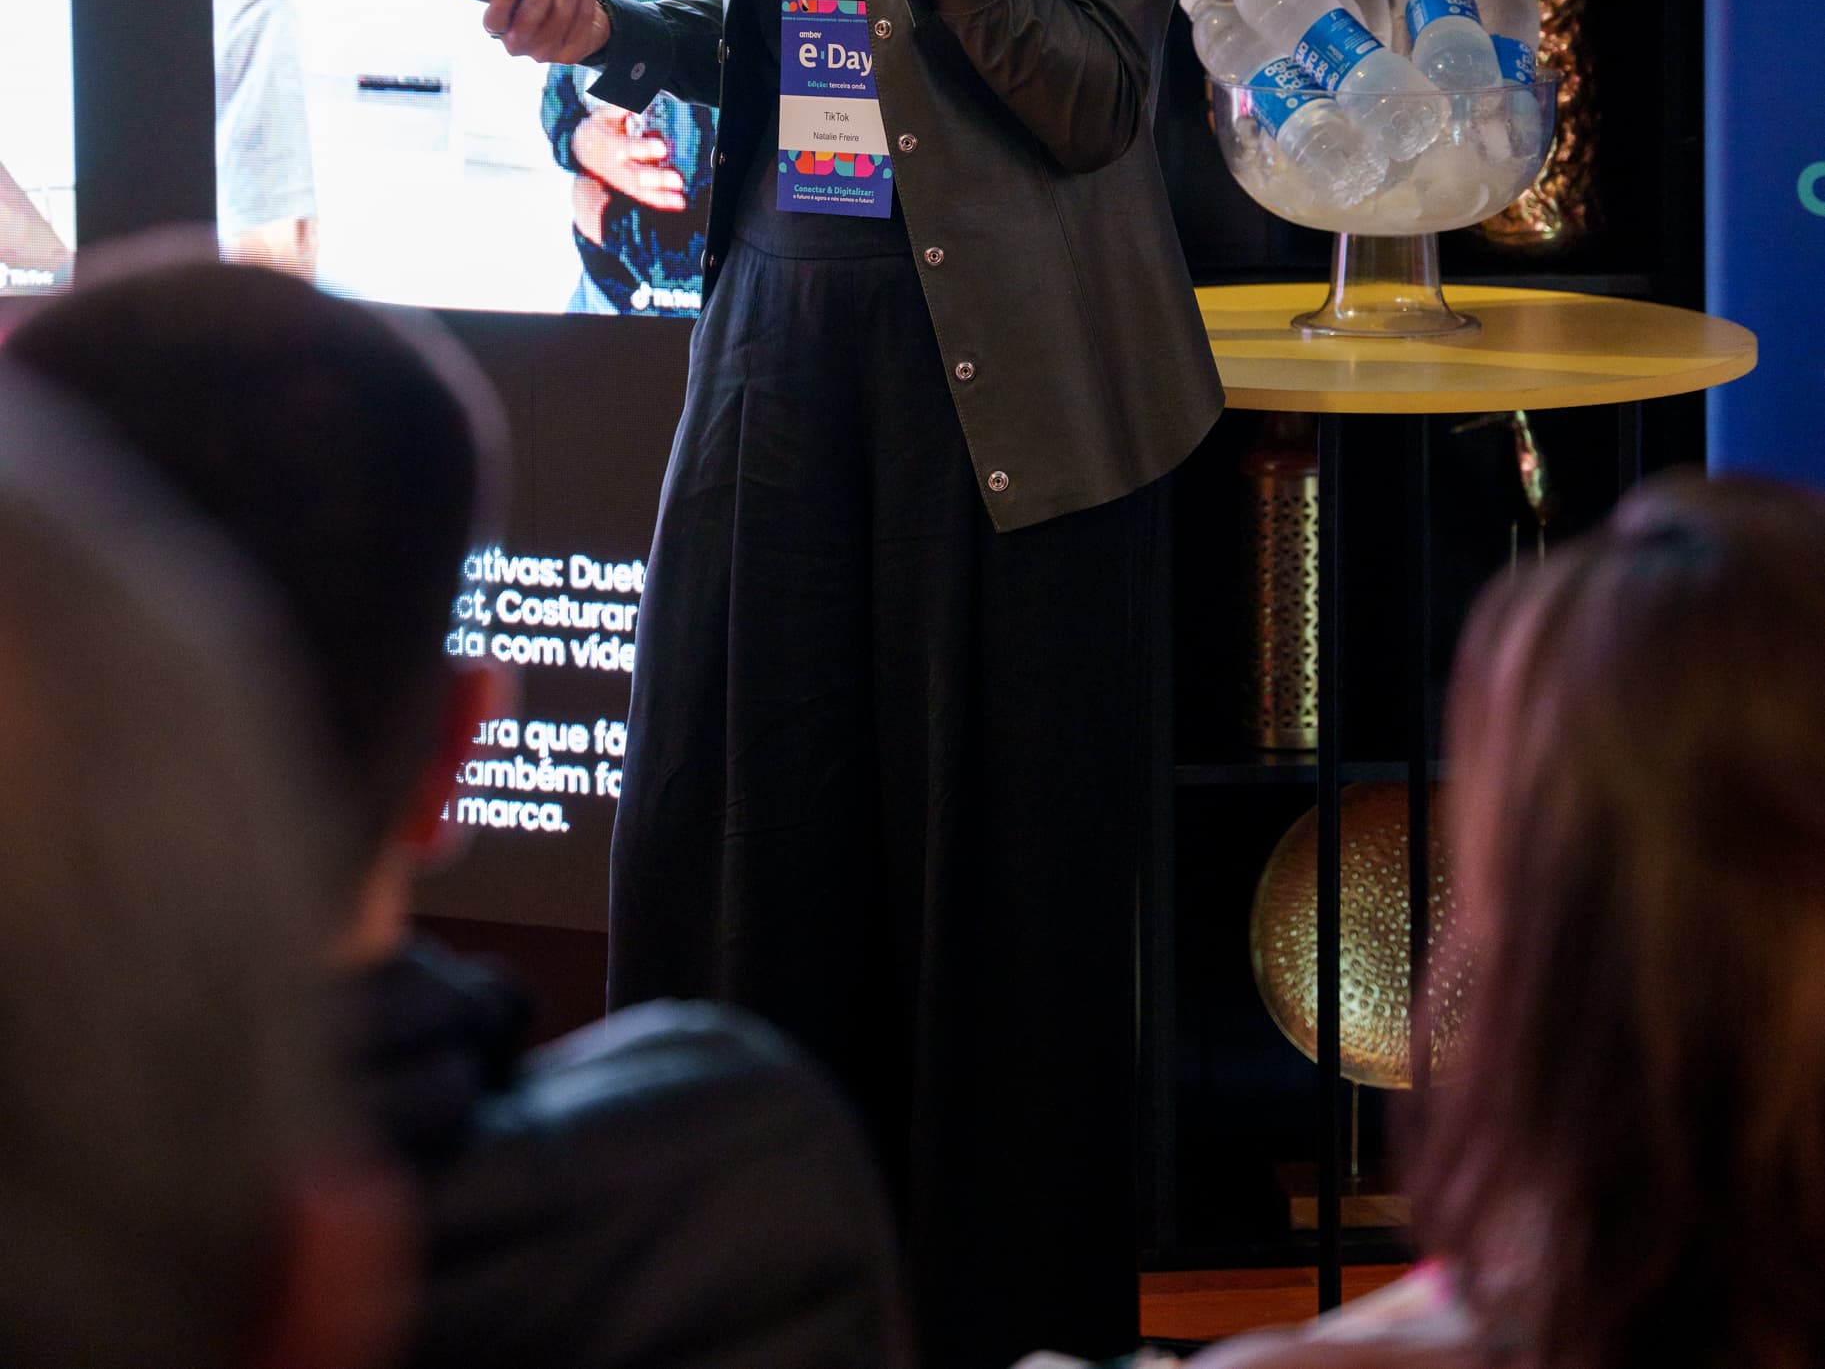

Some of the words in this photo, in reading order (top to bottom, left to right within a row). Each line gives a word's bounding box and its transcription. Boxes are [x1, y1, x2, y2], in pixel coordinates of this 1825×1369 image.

[799, 31, 822, 39] ambev
[824, 112, 850, 122] TikTok
[813, 131, 838, 141] Natalie
[839, 133, 860, 142] Freire
[794, 184, 826, 194] Conectar
[569, 554, 646, 593] Duet
[496, 589, 638, 631] Costurar
[491, 633, 565, 666] com
[524, 720, 590, 758] que
[457, 796, 570, 832] marca.
